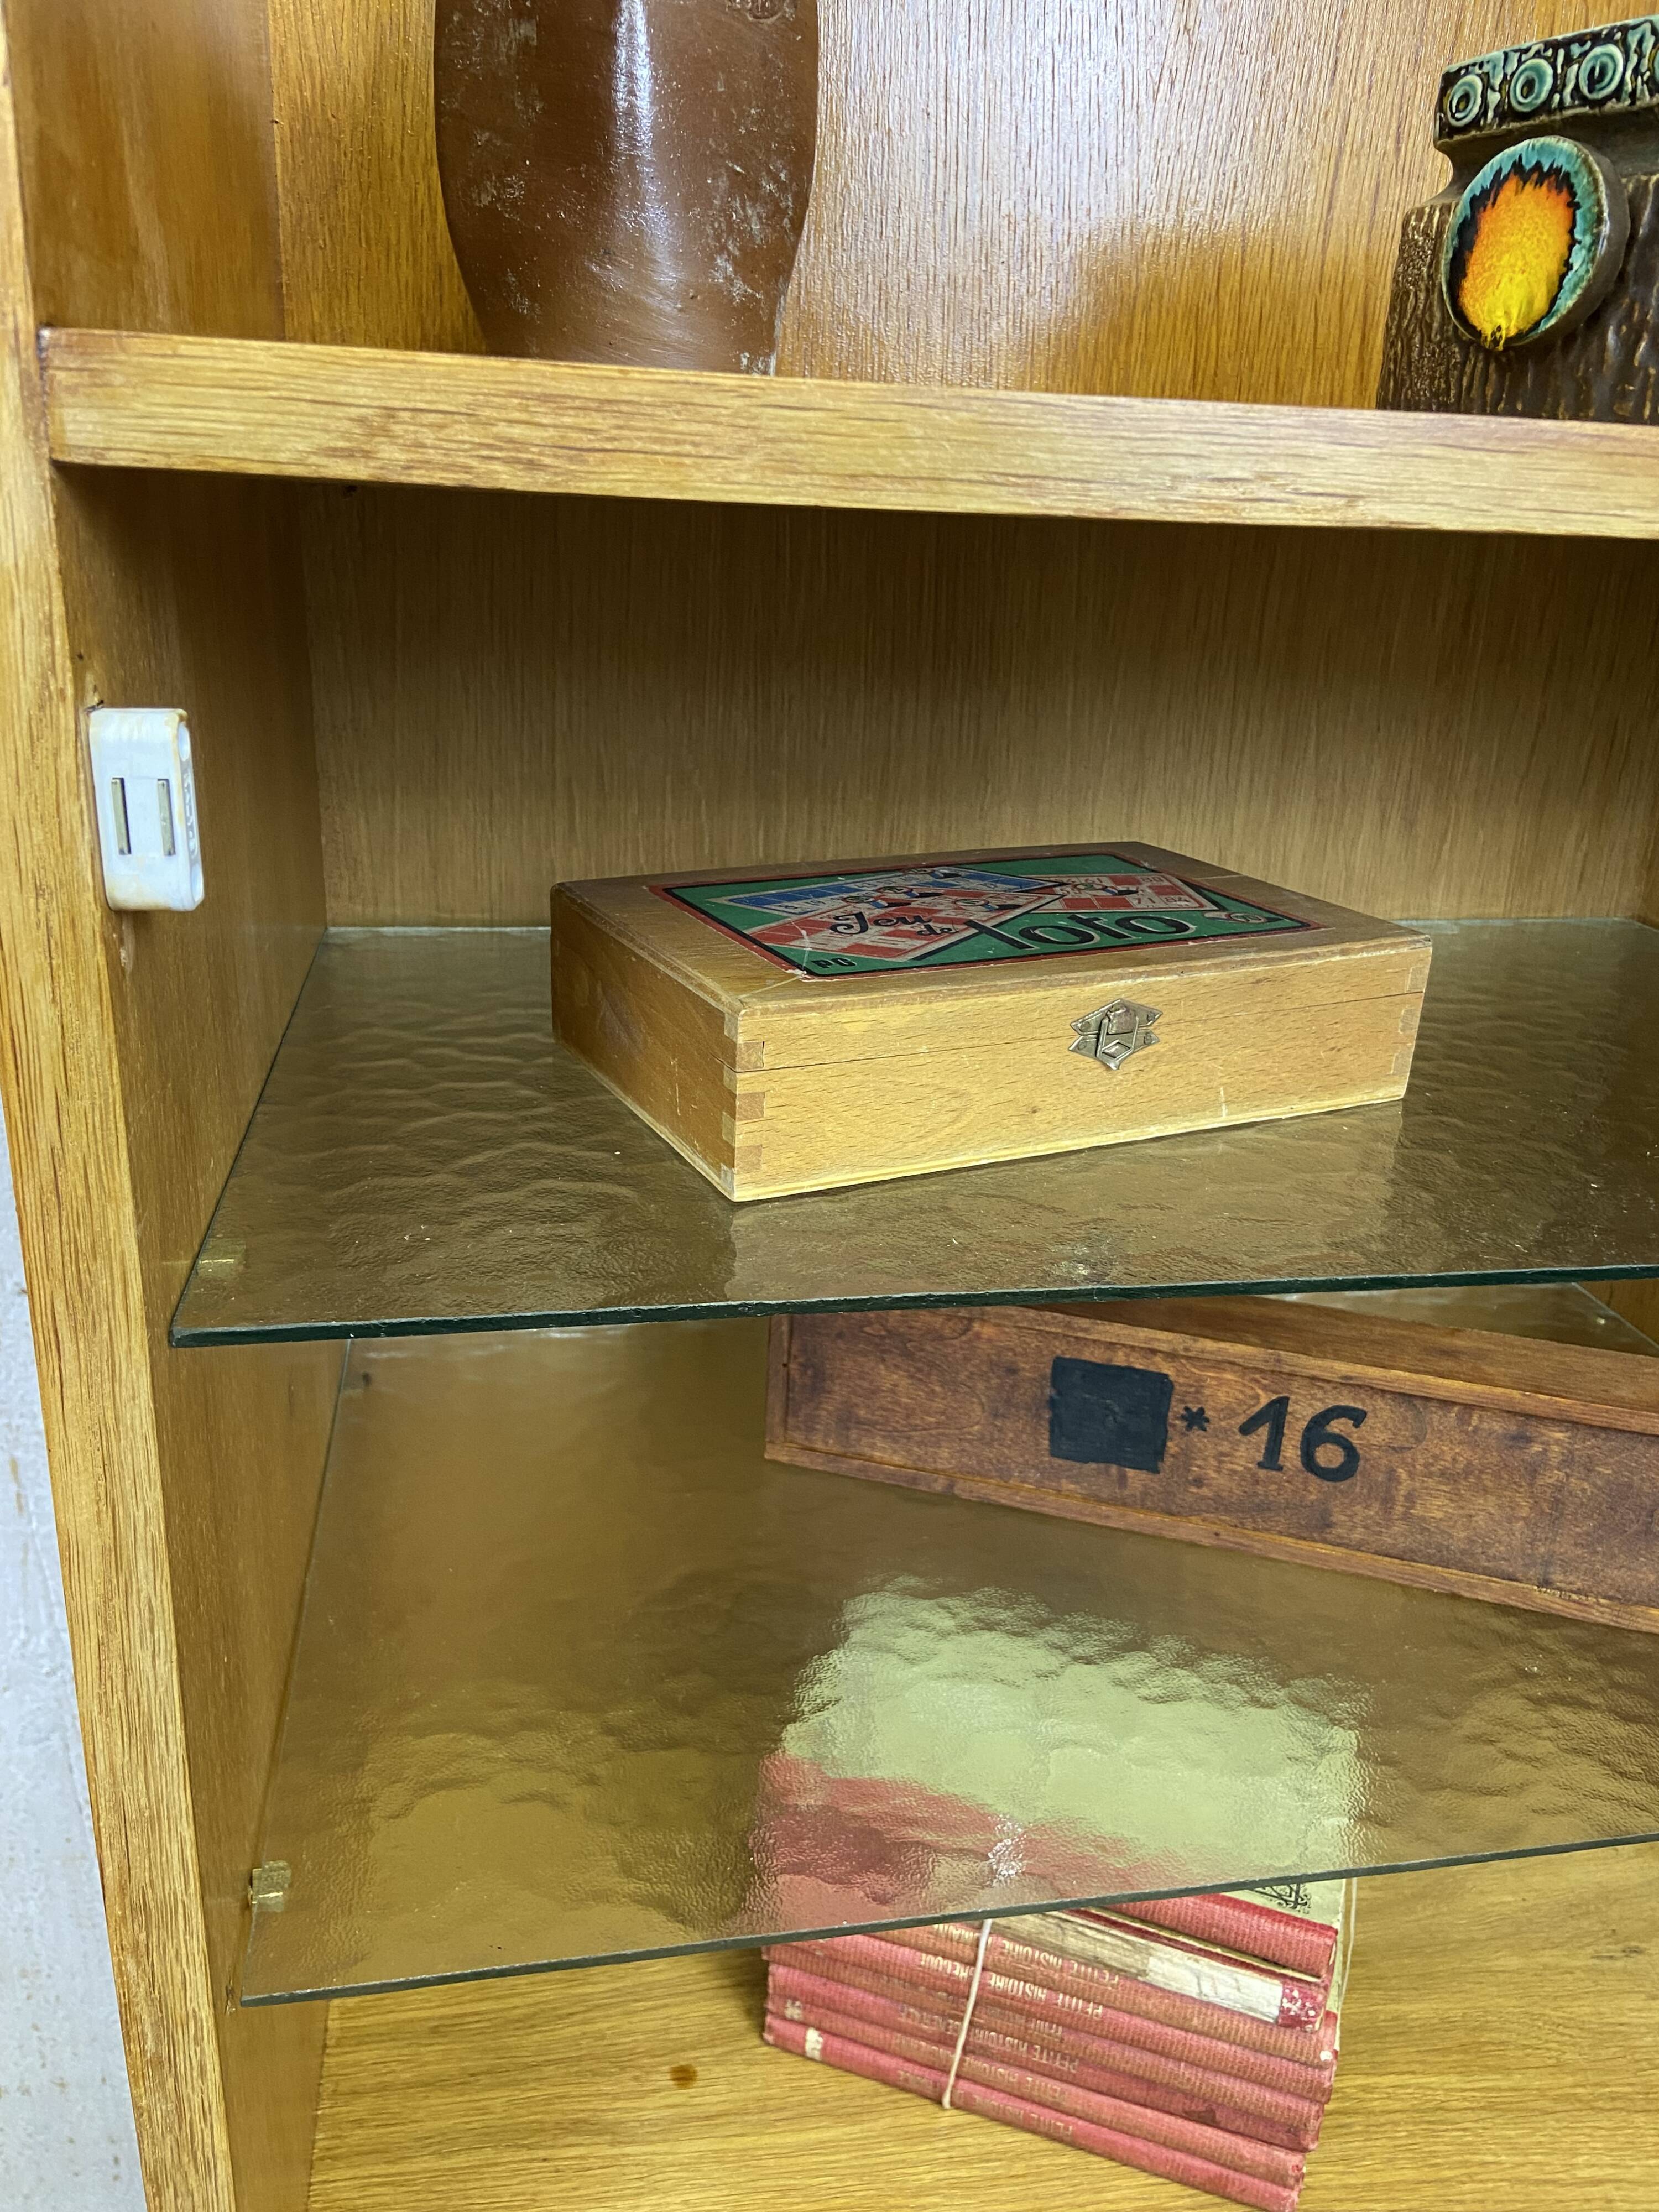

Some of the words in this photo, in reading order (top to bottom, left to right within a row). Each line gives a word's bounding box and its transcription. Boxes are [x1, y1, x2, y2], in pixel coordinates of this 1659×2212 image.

[830, 912, 932, 935] Jeu
[916, 924, 959, 935] de
[963, 913, 1196, 949] loto
[1239, 1395, 1367, 1482] 16
[1001, 1940, 1062, 1969] HISTOIRE
[987, 1971, 1047, 2001] HISTOIRE
[1070, 1960, 1119, 1985] PETITE
[1057, 1992, 1103, 2019] PETITE
[1032, 2044, 1079, 2074] PETITE
